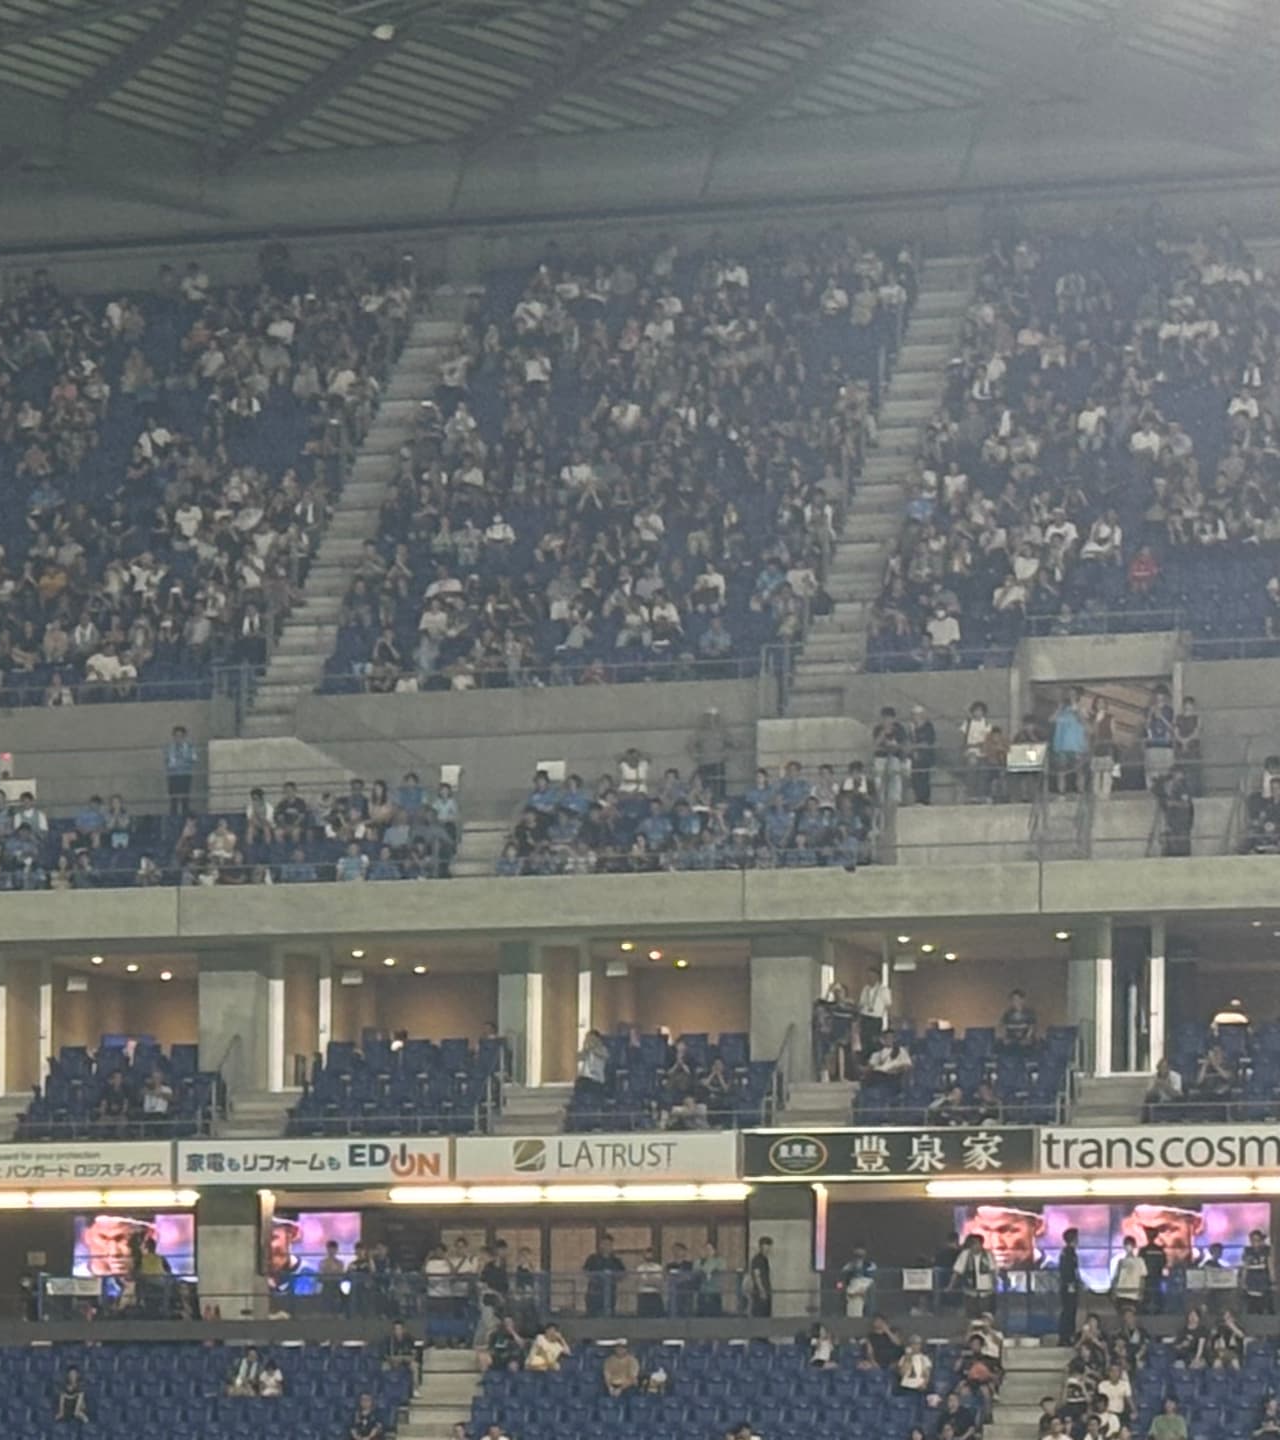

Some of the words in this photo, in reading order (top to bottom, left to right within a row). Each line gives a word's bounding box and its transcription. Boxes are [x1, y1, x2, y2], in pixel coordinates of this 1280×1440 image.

[186, 1152, 341, 1173] 家電もリフォームも
[348, 1143, 441, 1177] EDION
[557, 1142, 677, 1169] LATRUST
